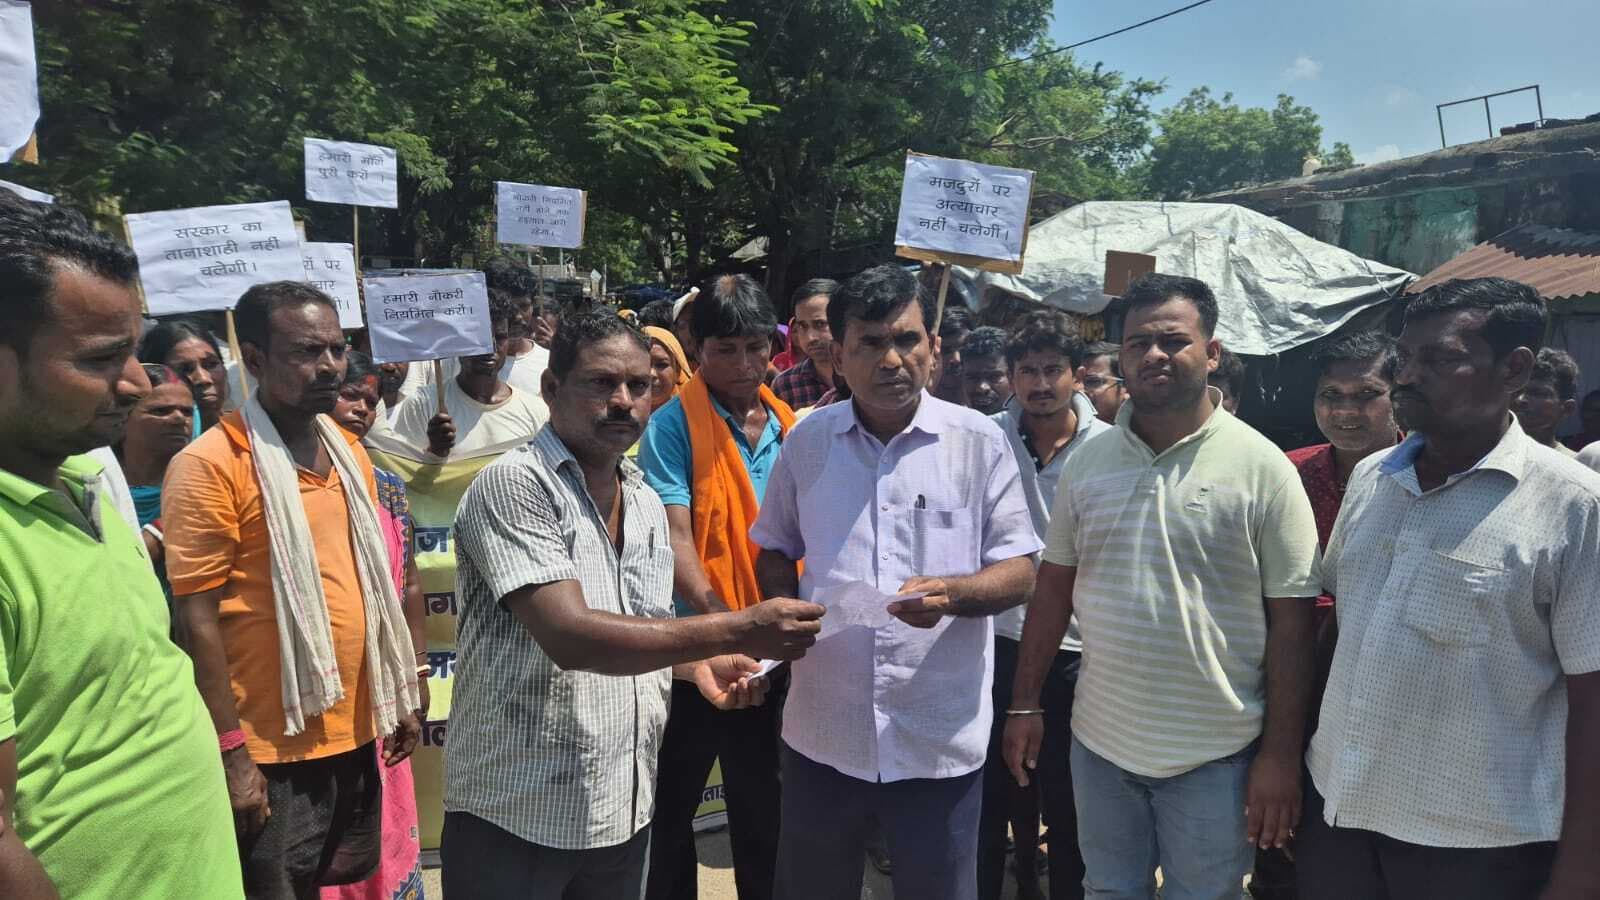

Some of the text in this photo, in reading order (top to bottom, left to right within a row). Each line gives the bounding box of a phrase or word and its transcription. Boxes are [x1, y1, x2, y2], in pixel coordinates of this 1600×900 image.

[992, 184, 1010, 197] पर
[935, 199, 1000, 217] अत्याचार
[174, 221, 262, 239] सरकार का
[164, 241, 239, 261] तानाशाही
[324, 260, 342, 270] पर
[383, 290, 418, 304] हमारी
